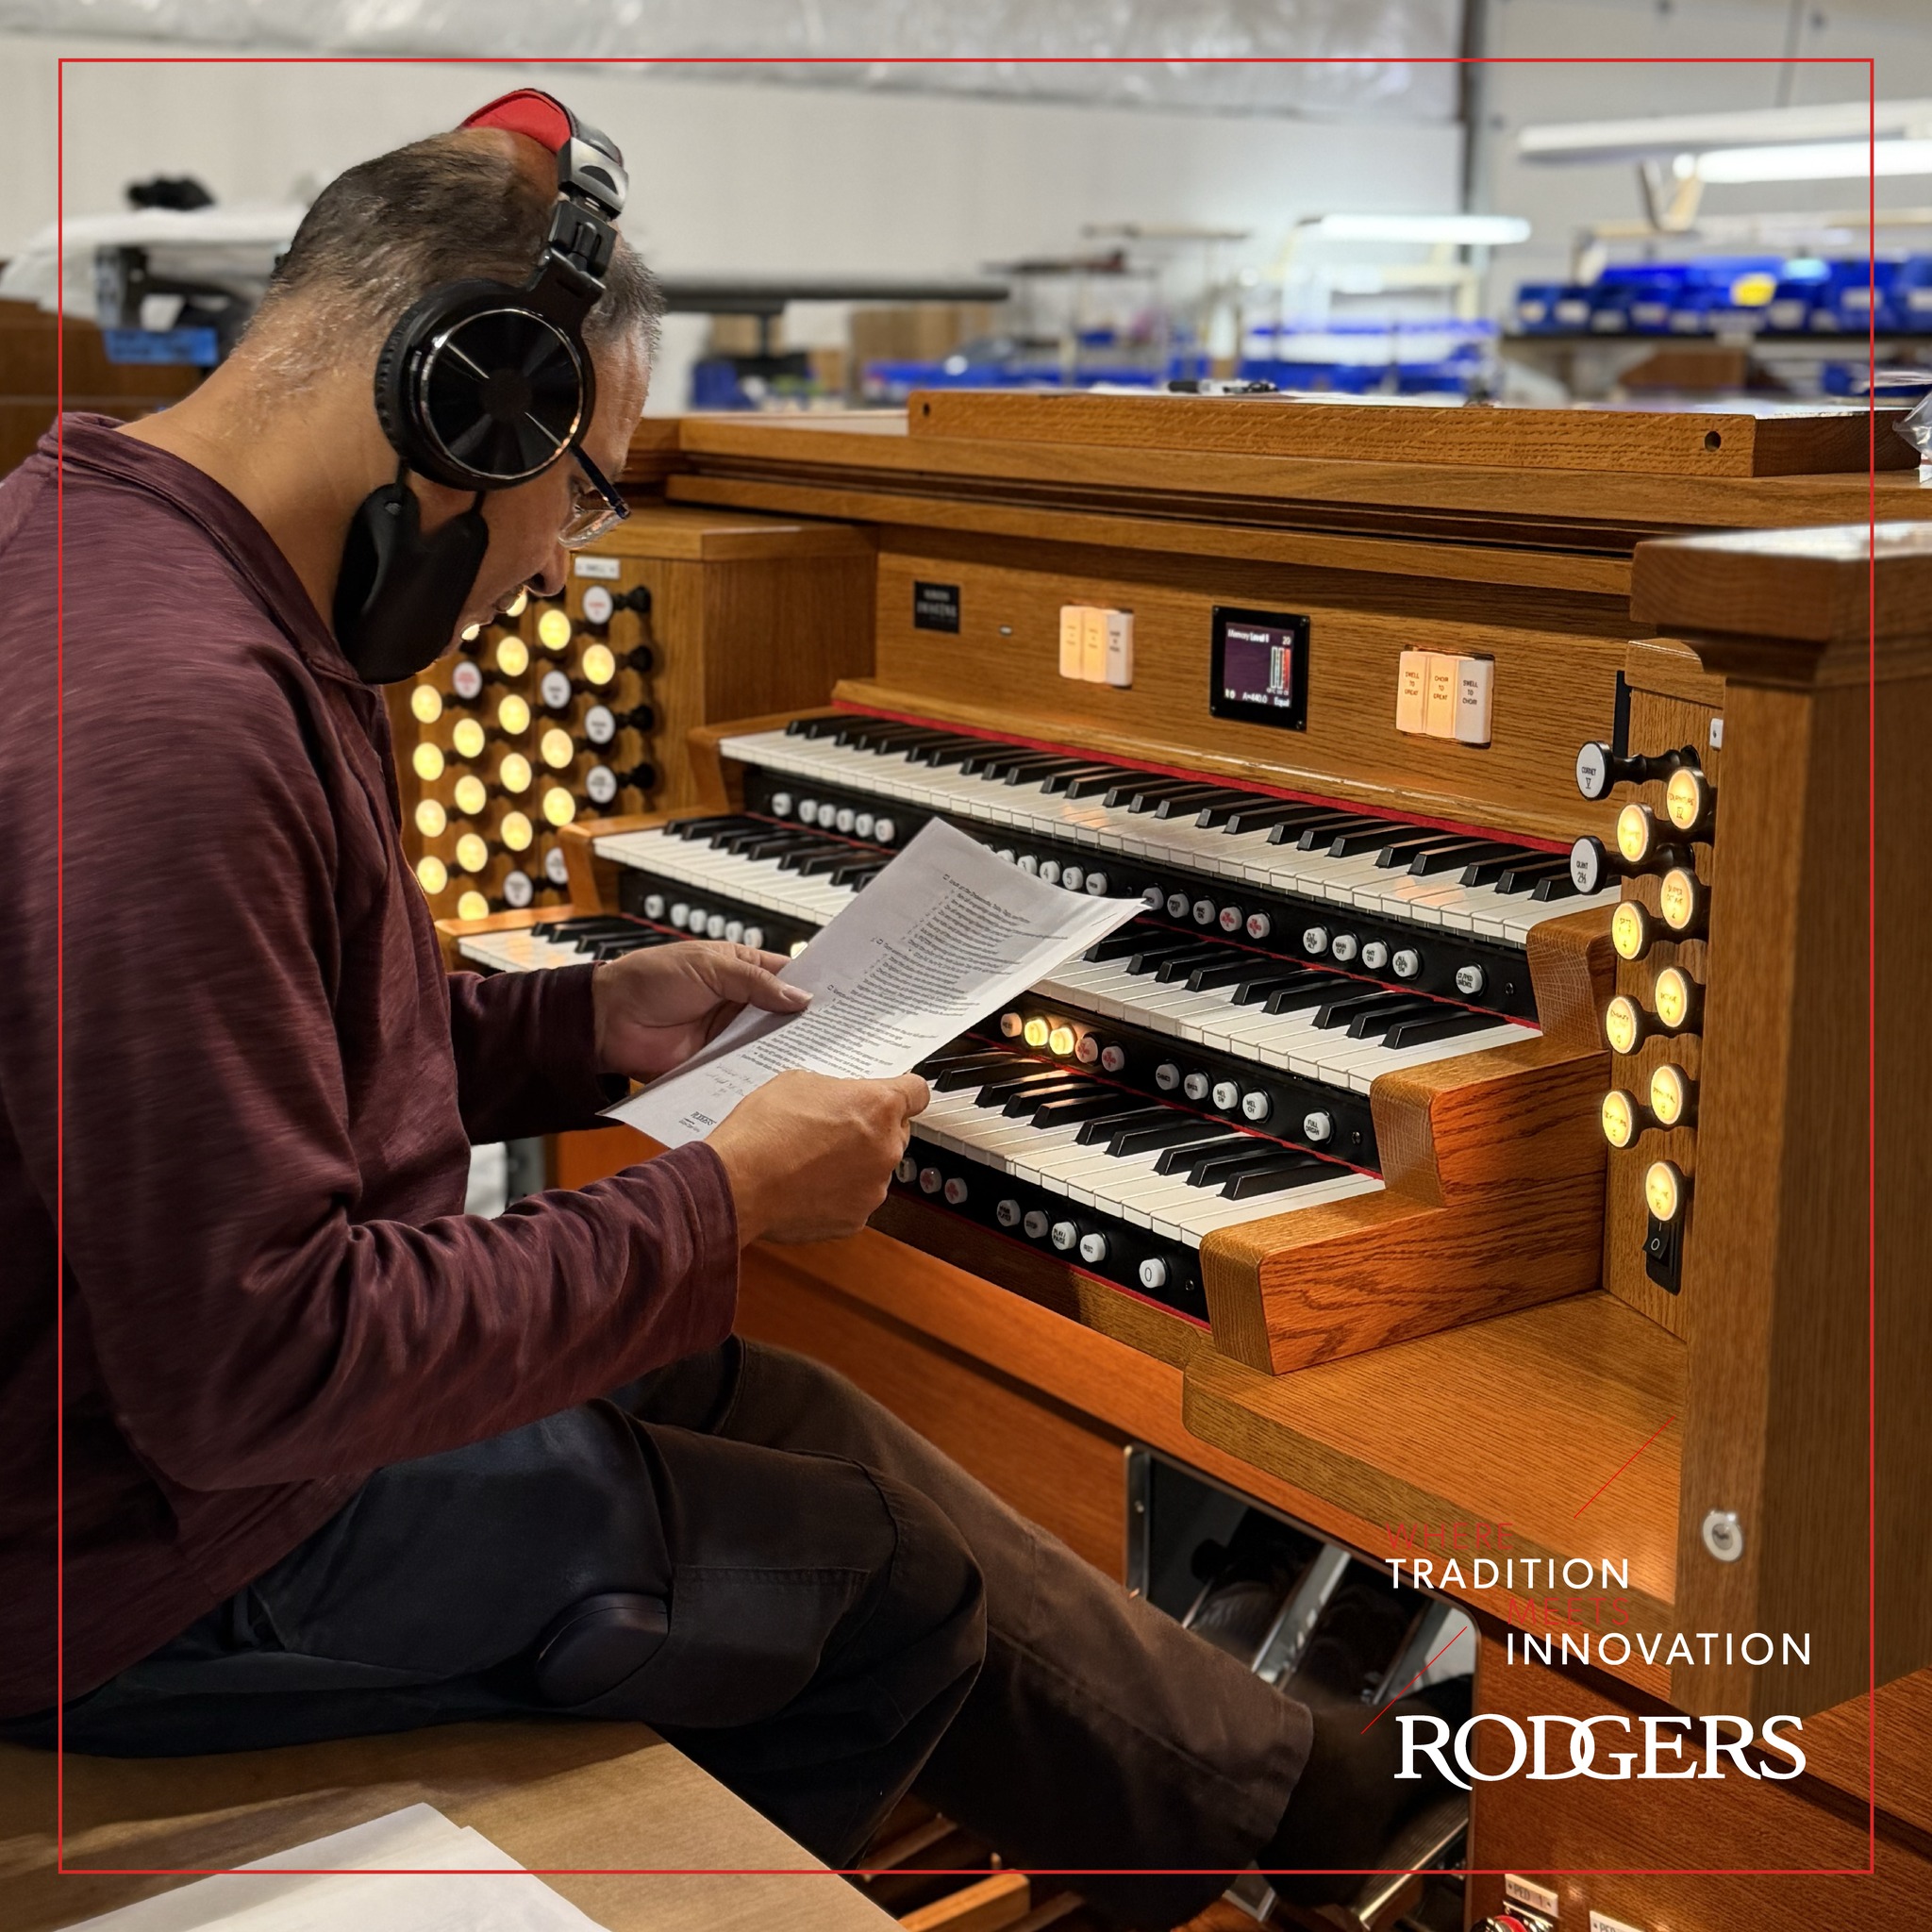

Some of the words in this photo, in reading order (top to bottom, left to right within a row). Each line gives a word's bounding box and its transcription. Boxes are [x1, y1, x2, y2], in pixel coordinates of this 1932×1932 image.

[1463, 679, 1478, 688] SWELL
[1581, 766, 1597, 775] CORNET
[1575, 860, 1589, 870] QUINT
[1043, 868, 1049, 878] 4
[1066, 873, 1073, 885] 5
[1217, 1089, 1226, 1097] MEL
[1246, 1100, 1257, 1108] MEL
[1307, 1120, 1319, 1129] FULL
[1306, 1125, 1320, 1136] ORGAN
[1513, 1887, 1530, 1901] PED
